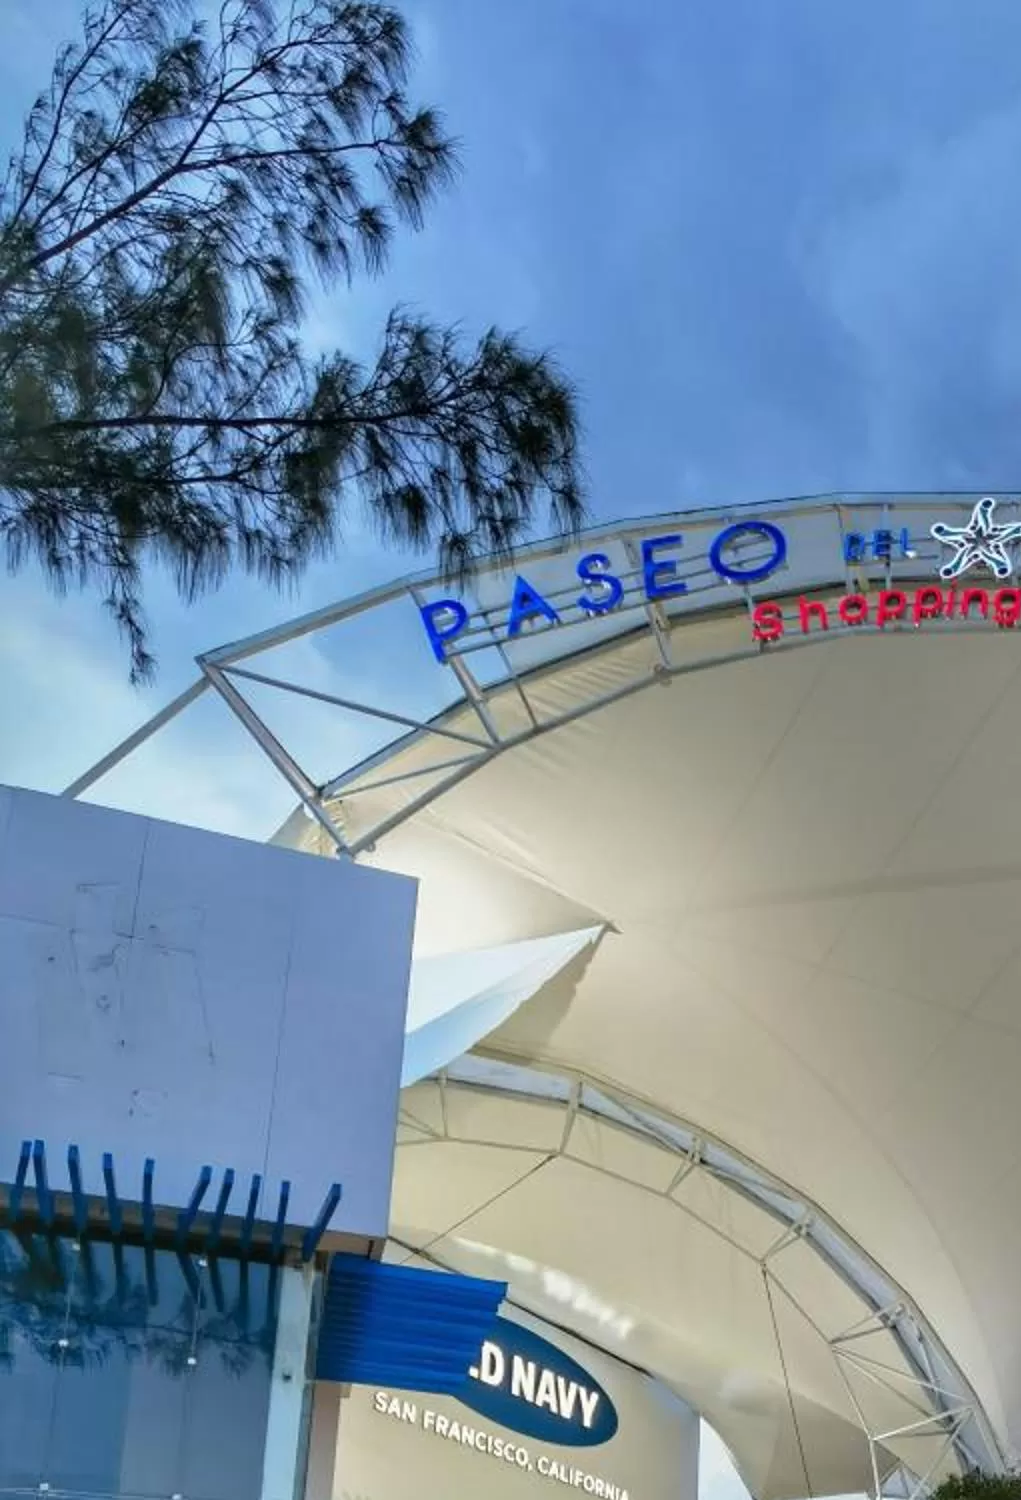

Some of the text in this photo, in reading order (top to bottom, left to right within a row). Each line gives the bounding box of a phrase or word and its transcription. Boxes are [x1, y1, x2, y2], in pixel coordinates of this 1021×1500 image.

[421, 521, 786, 663] PASEO
[843, 527, 916, 561] DEL
[373, 1390, 417, 1424] SAN
[423, 1411, 534, 1472] FRANCISCO,
[511, 1354, 599, 1428] NAVY
